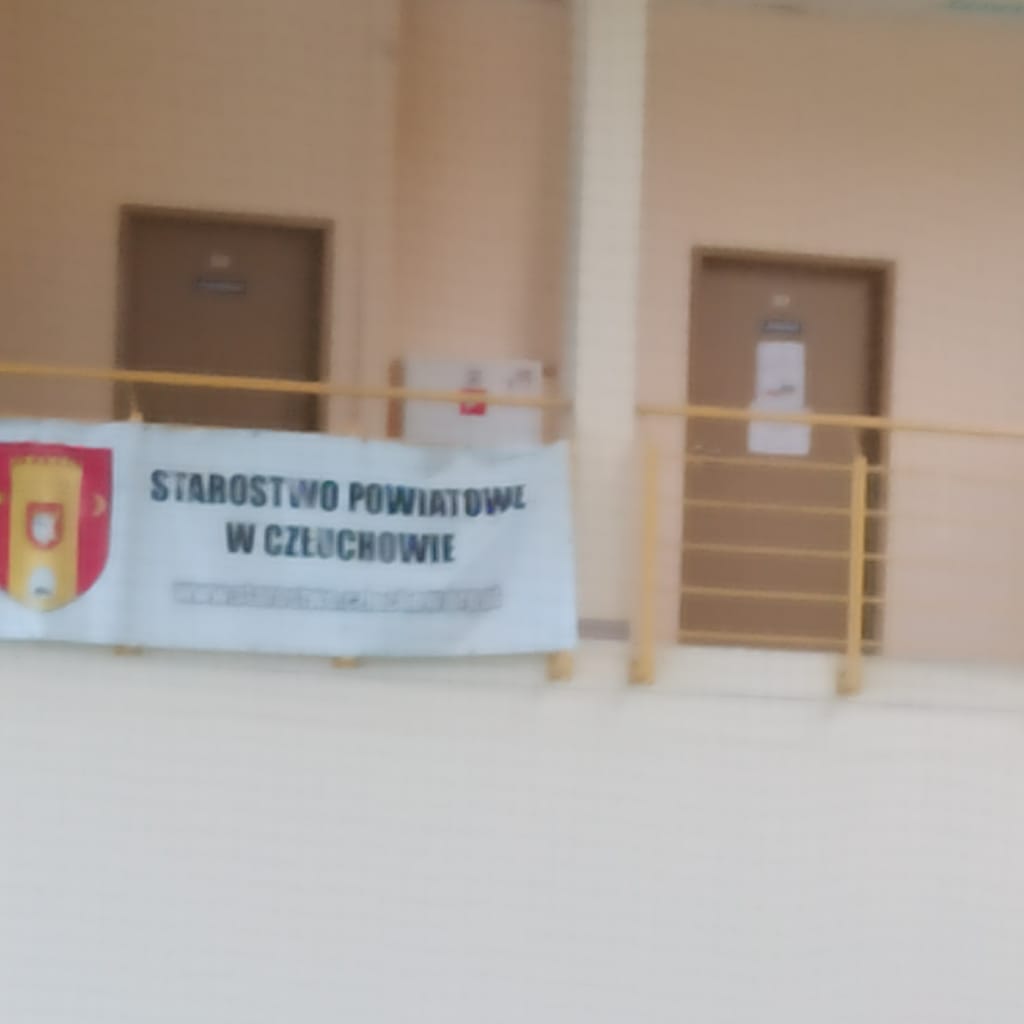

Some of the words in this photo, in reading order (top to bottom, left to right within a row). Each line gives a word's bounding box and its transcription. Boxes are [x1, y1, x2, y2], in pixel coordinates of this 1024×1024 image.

[150, 469, 340, 512] STAROSTWO
[348, 481, 526, 517] POWIATOWE
[225, 521, 255, 554] W
